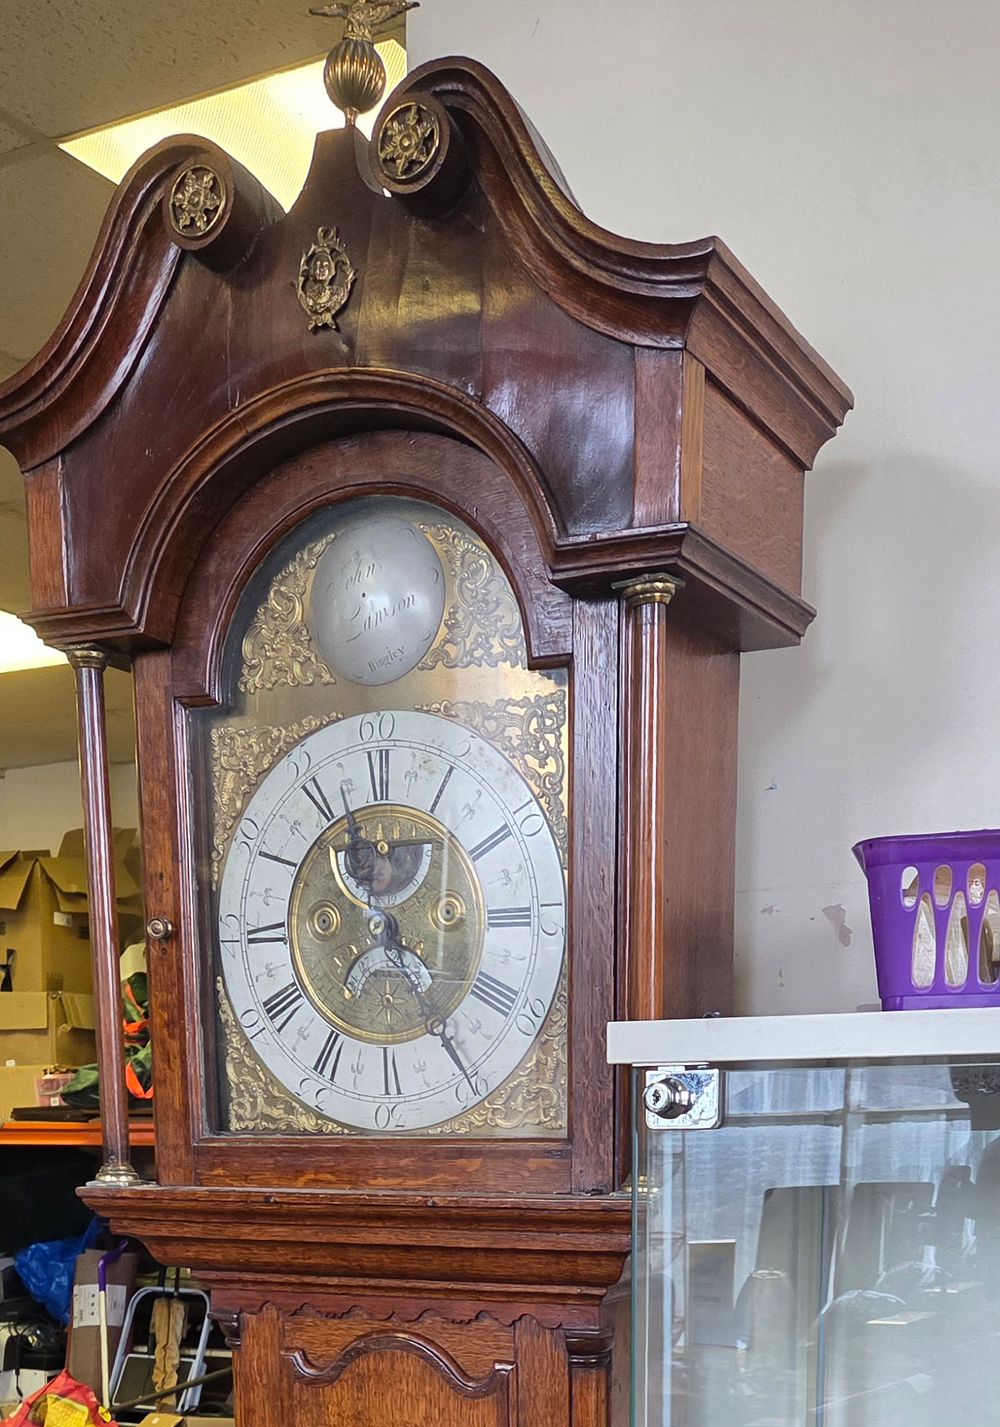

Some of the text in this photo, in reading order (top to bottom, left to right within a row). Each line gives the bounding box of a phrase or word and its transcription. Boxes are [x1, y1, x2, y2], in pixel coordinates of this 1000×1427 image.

[359, 711, 395, 742] 60
[512, 799, 545, 838] 10
[487, 905, 533, 929] III
[540, 902, 565, 937] 15
[220, 913, 241, 960] 45
[514, 998, 546, 1037] 20
